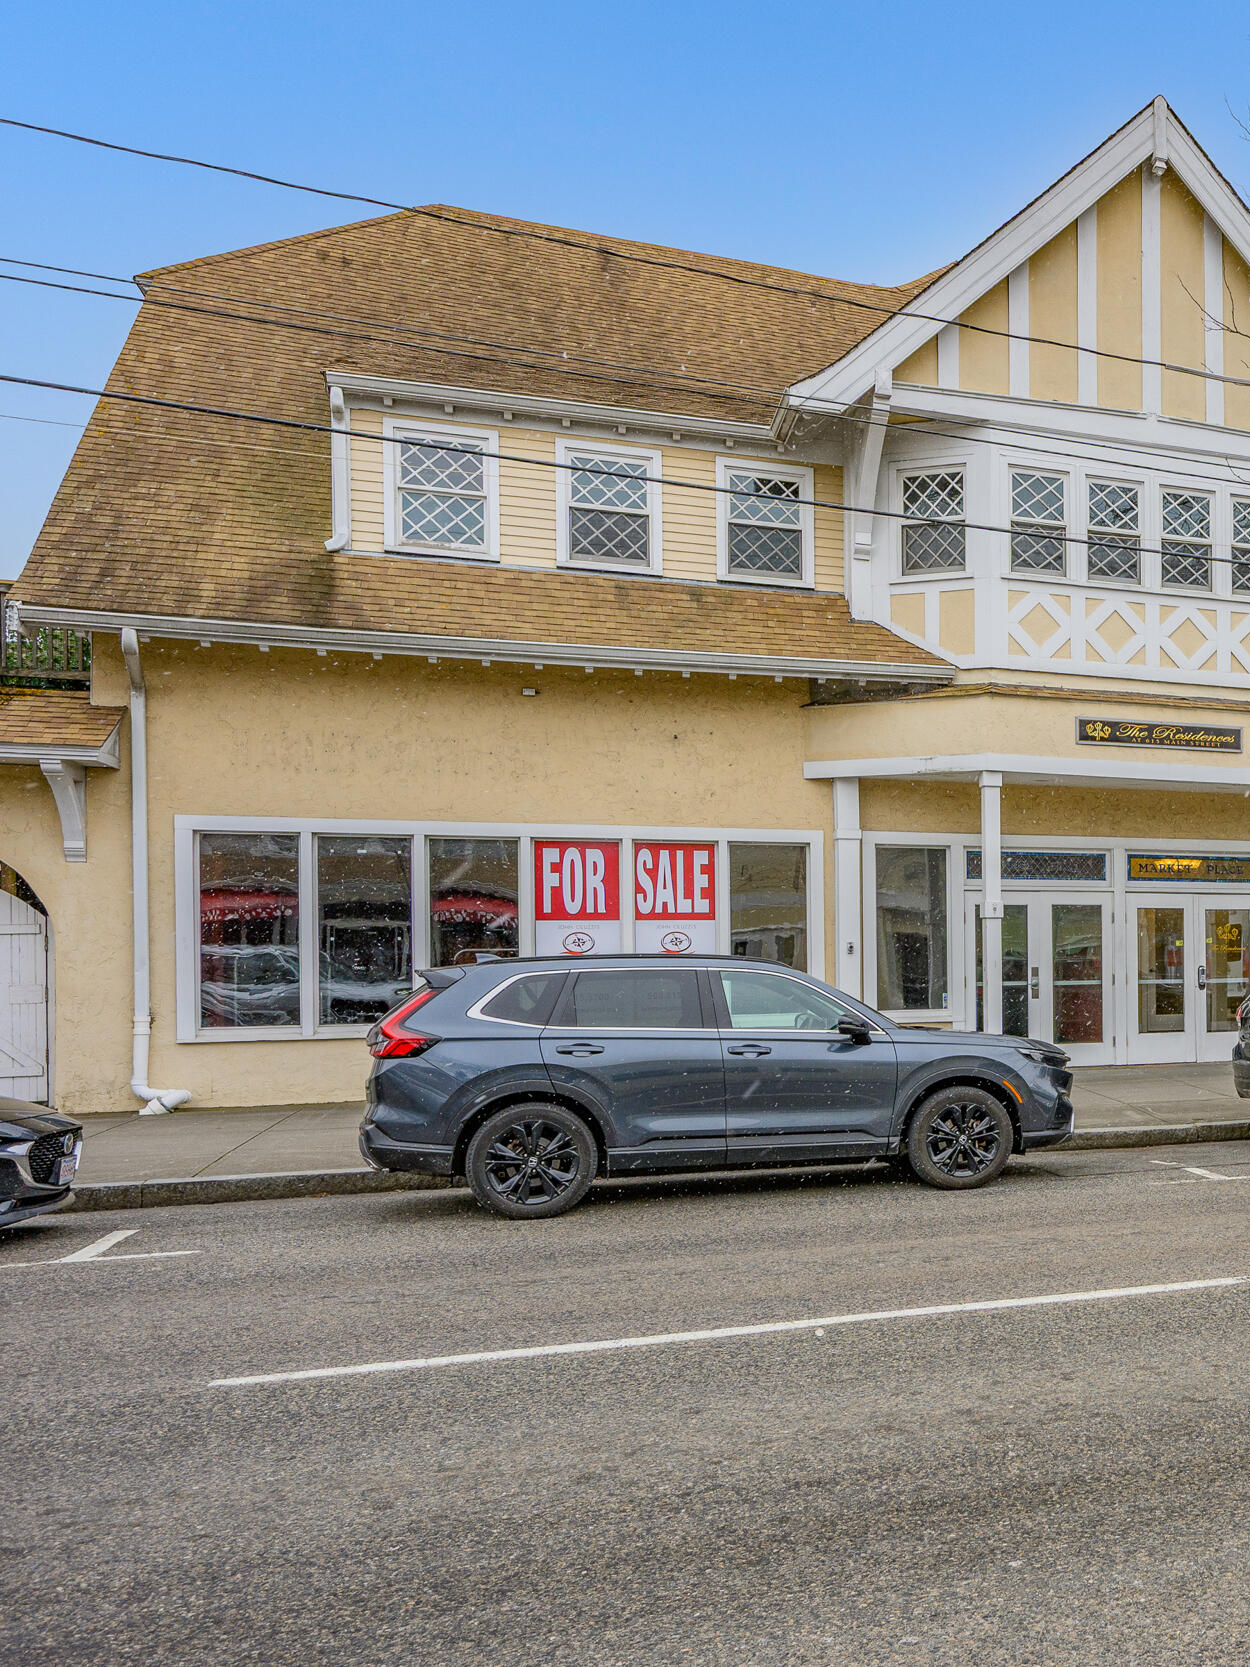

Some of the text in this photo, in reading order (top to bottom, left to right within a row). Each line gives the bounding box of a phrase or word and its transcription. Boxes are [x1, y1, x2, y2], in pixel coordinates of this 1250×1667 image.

[1116, 723, 1235, 743] The Residences
[1138, 863, 1244, 875] MARKET PLACE
[542, 847, 710, 915] FOR SALE
